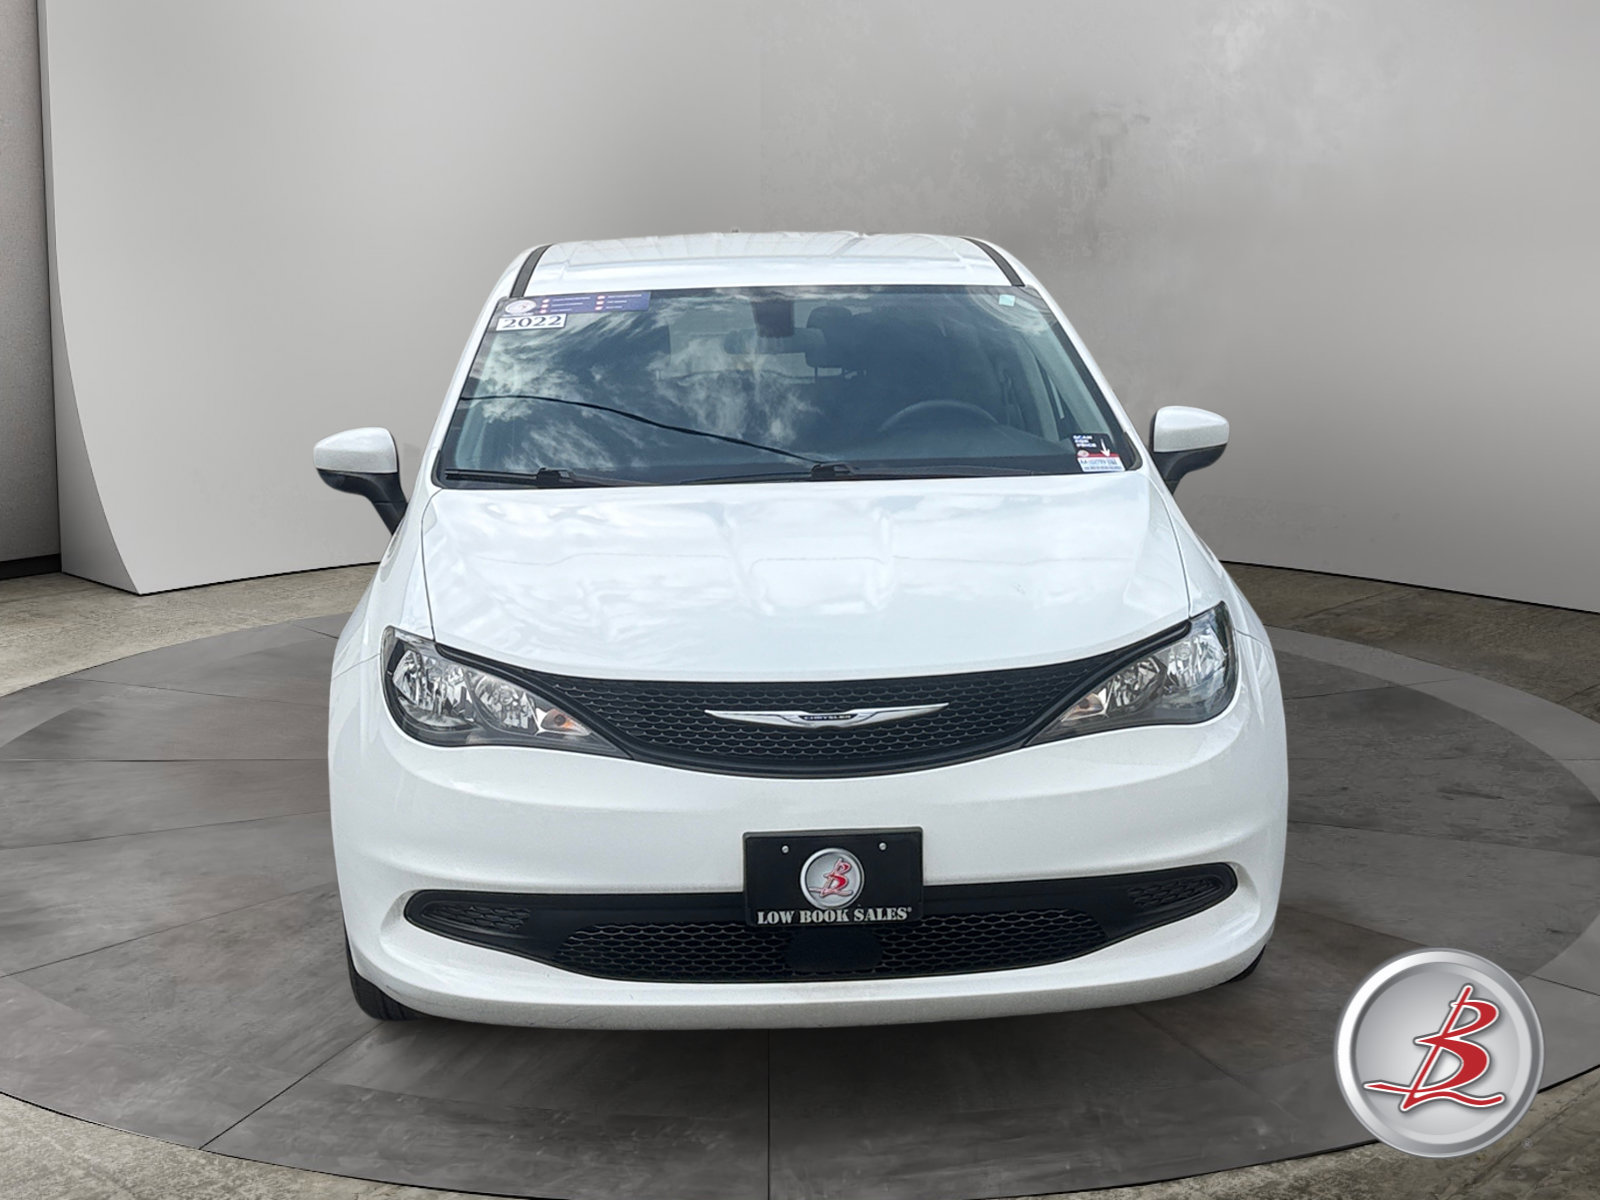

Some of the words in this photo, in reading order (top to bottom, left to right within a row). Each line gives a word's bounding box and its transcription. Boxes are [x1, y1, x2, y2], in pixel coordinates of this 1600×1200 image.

[502, 315, 562, 328] 2022
[757, 910, 795, 925] LOW
[800, 908, 850, 924] BOOK
